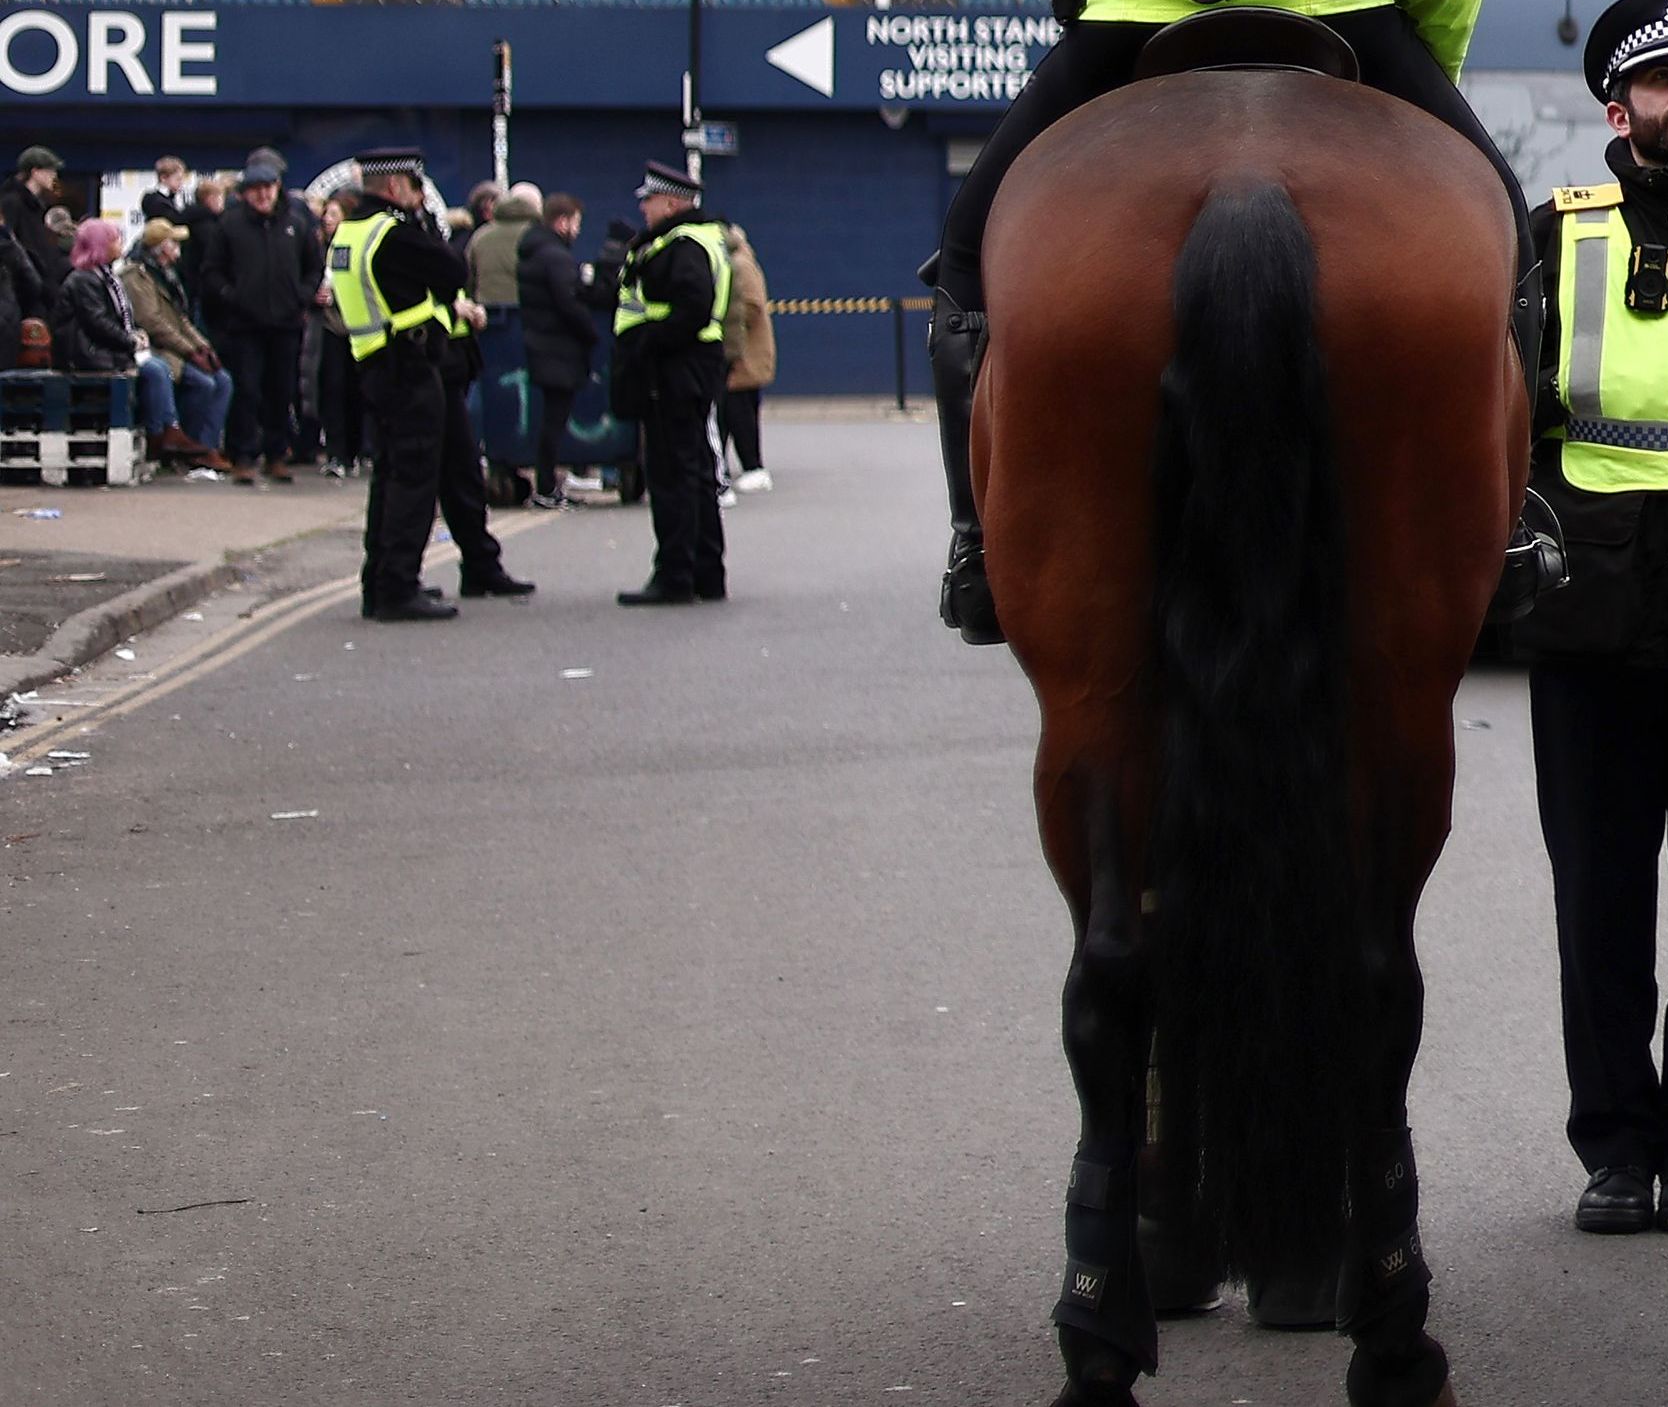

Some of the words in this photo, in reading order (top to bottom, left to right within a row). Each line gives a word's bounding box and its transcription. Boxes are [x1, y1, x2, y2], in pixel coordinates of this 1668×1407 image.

[867, 16, 967, 44] NORTH
[0, 9, 218, 96] ORE
[908, 45, 1027, 71] VISITING
